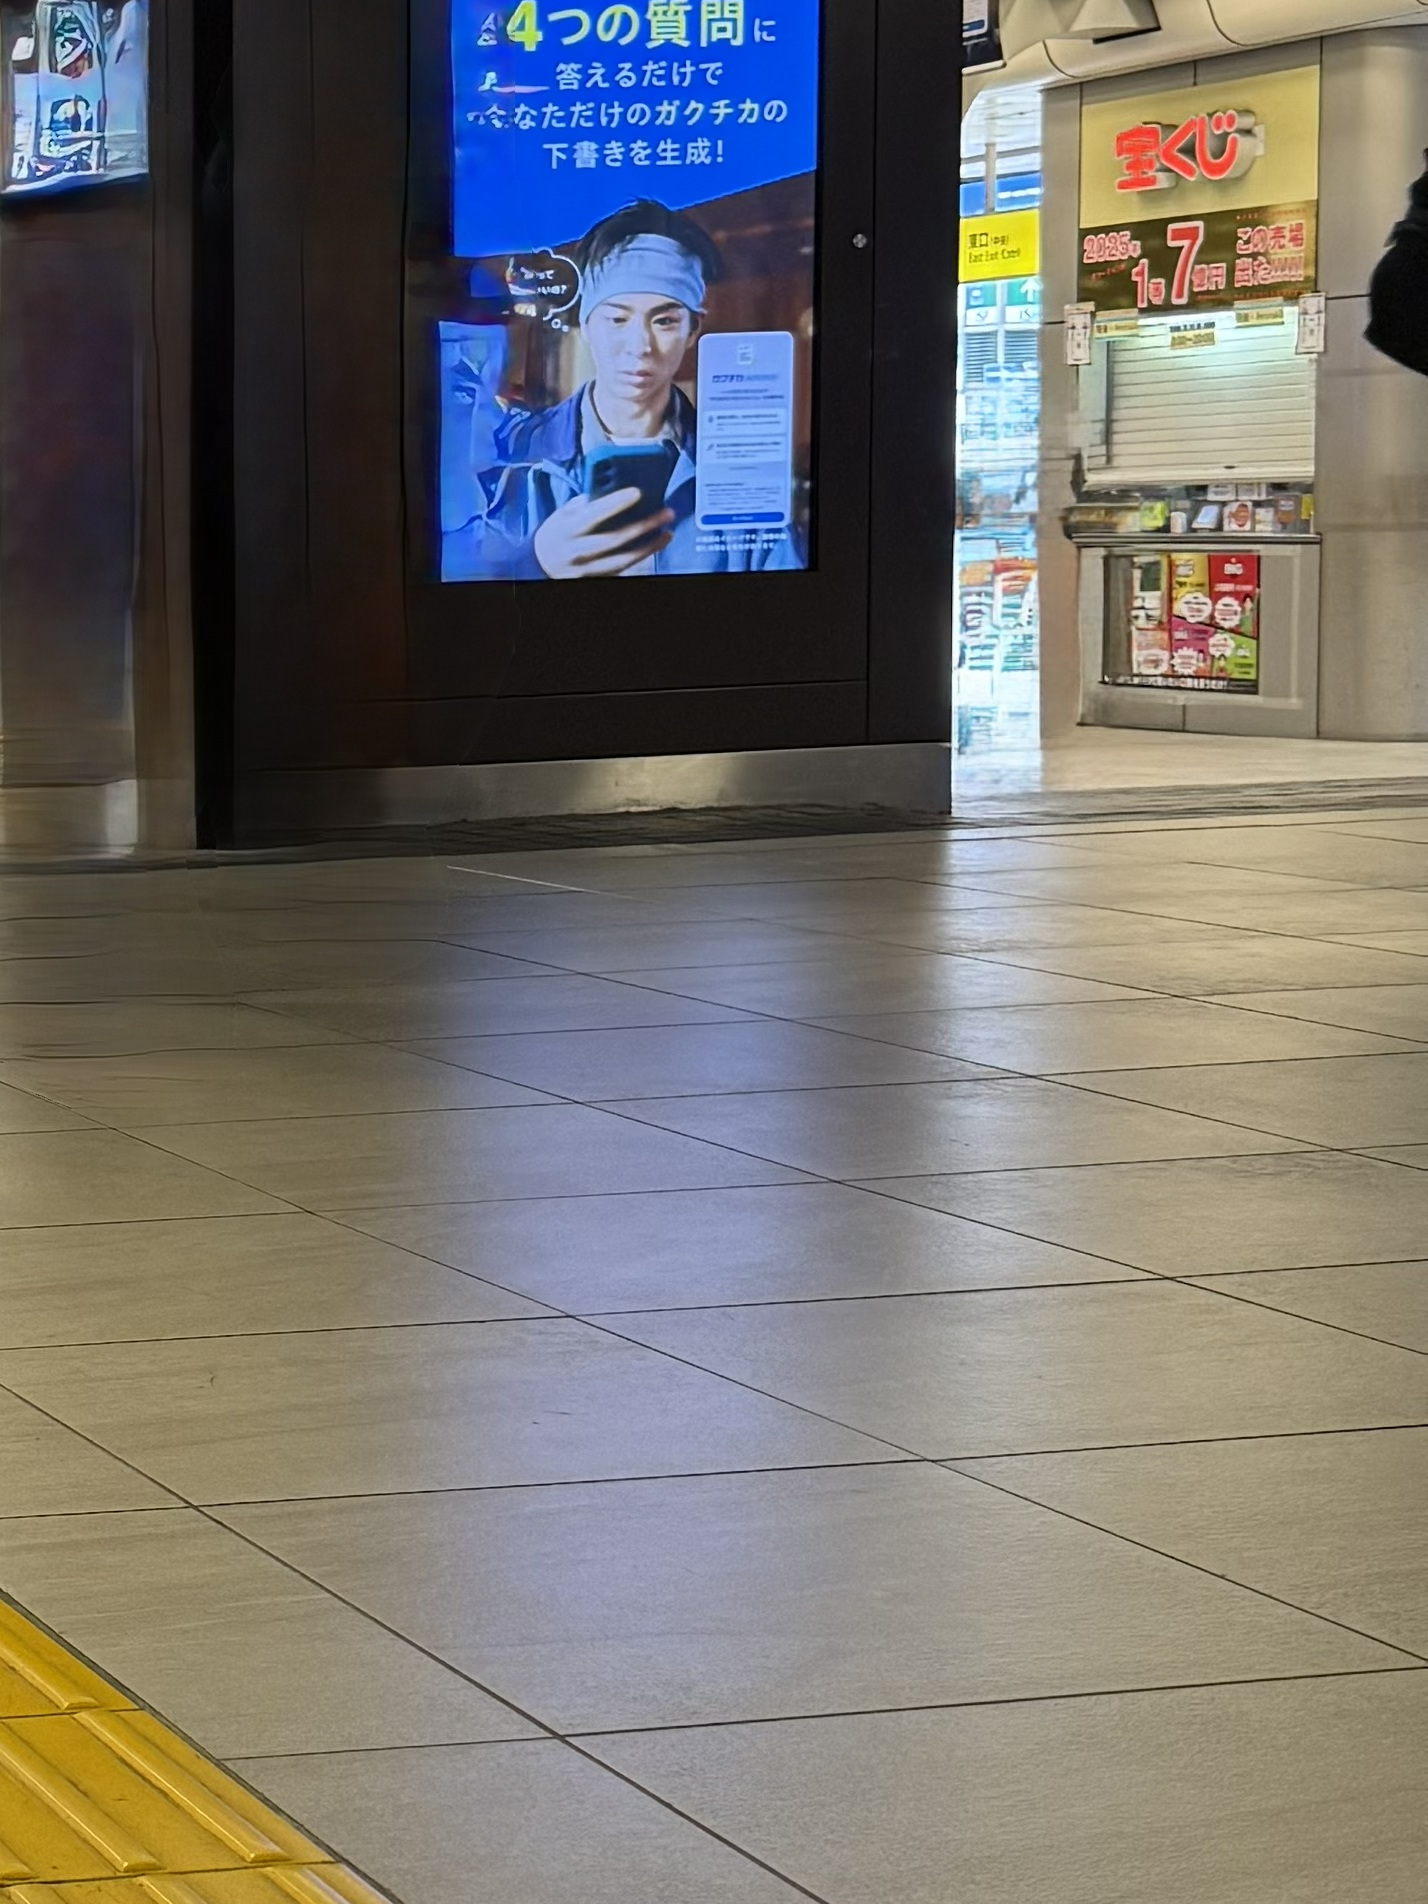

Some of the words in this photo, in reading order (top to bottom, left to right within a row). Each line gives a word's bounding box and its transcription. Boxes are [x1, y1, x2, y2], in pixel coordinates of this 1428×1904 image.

[556, 61, 724, 91] 答えるだけで
[1115, 109, 1241, 191] 宝くじ
